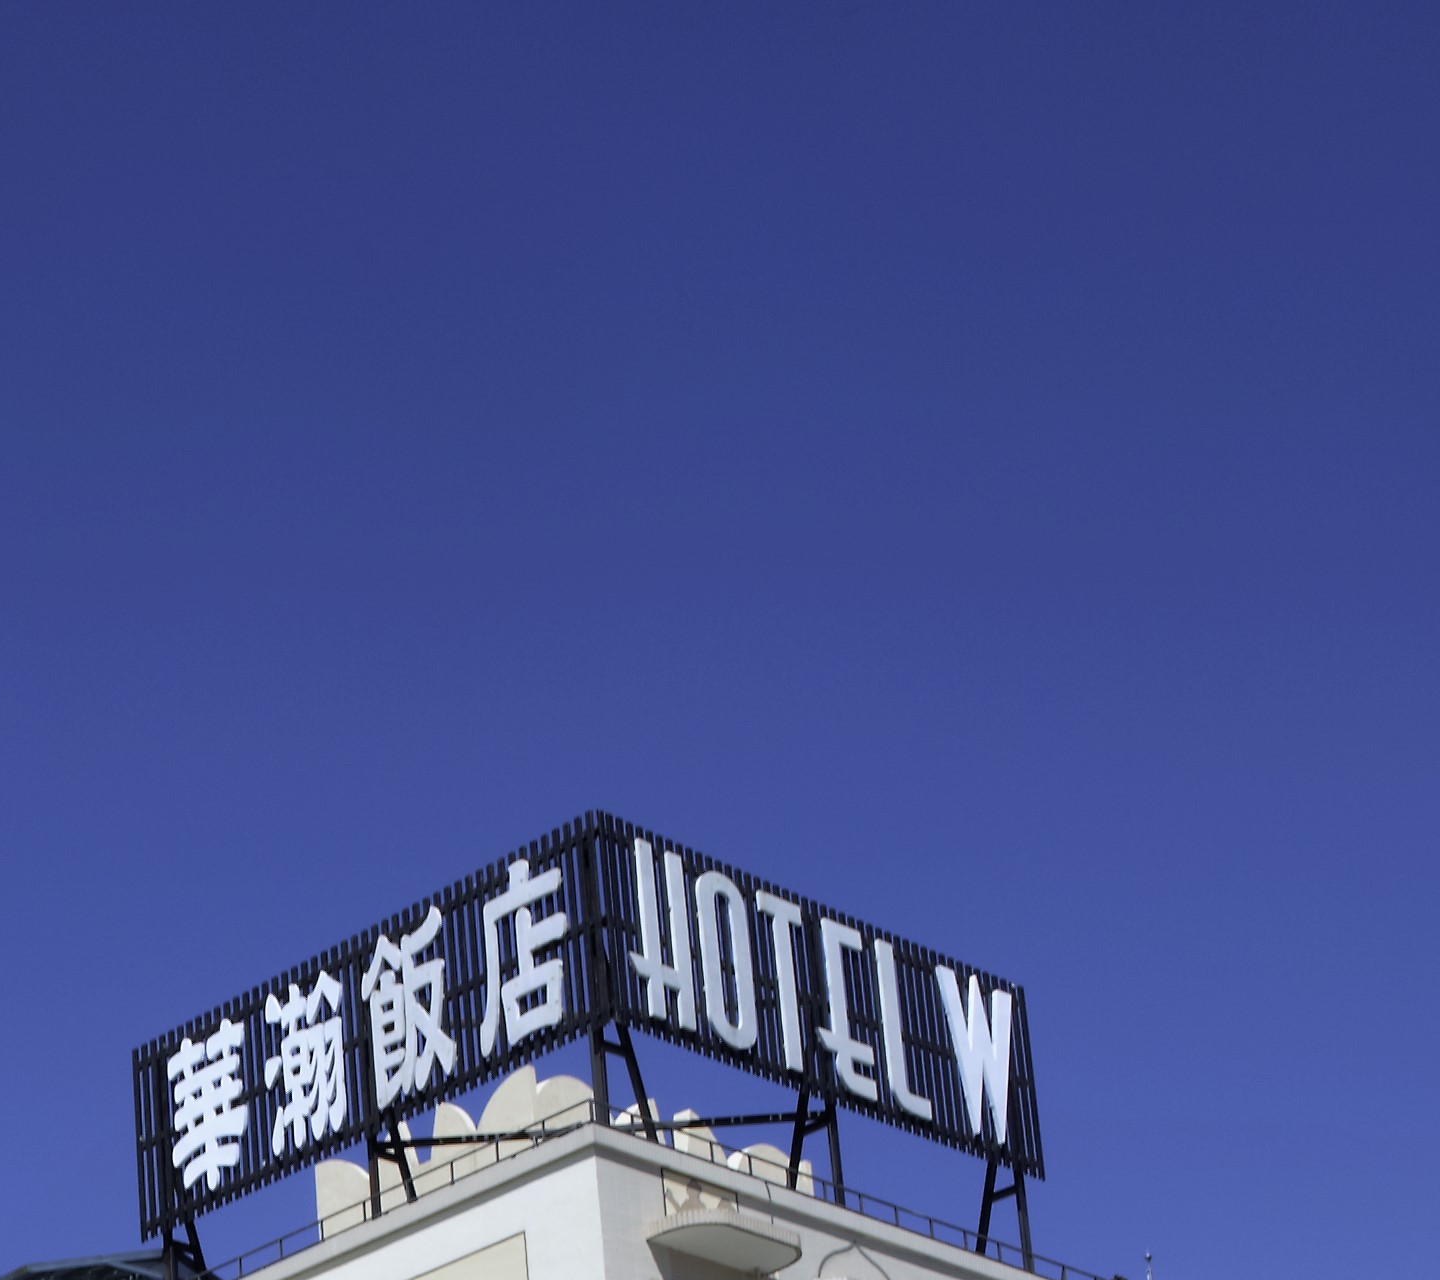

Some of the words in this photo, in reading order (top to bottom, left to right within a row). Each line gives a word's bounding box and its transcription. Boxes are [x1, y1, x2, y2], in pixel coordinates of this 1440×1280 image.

[167, 859, 569, 1191] 華瀚飯店
[628, 837, 933, 1121] HOTEL
[935, 964, 1012, 1145] W
